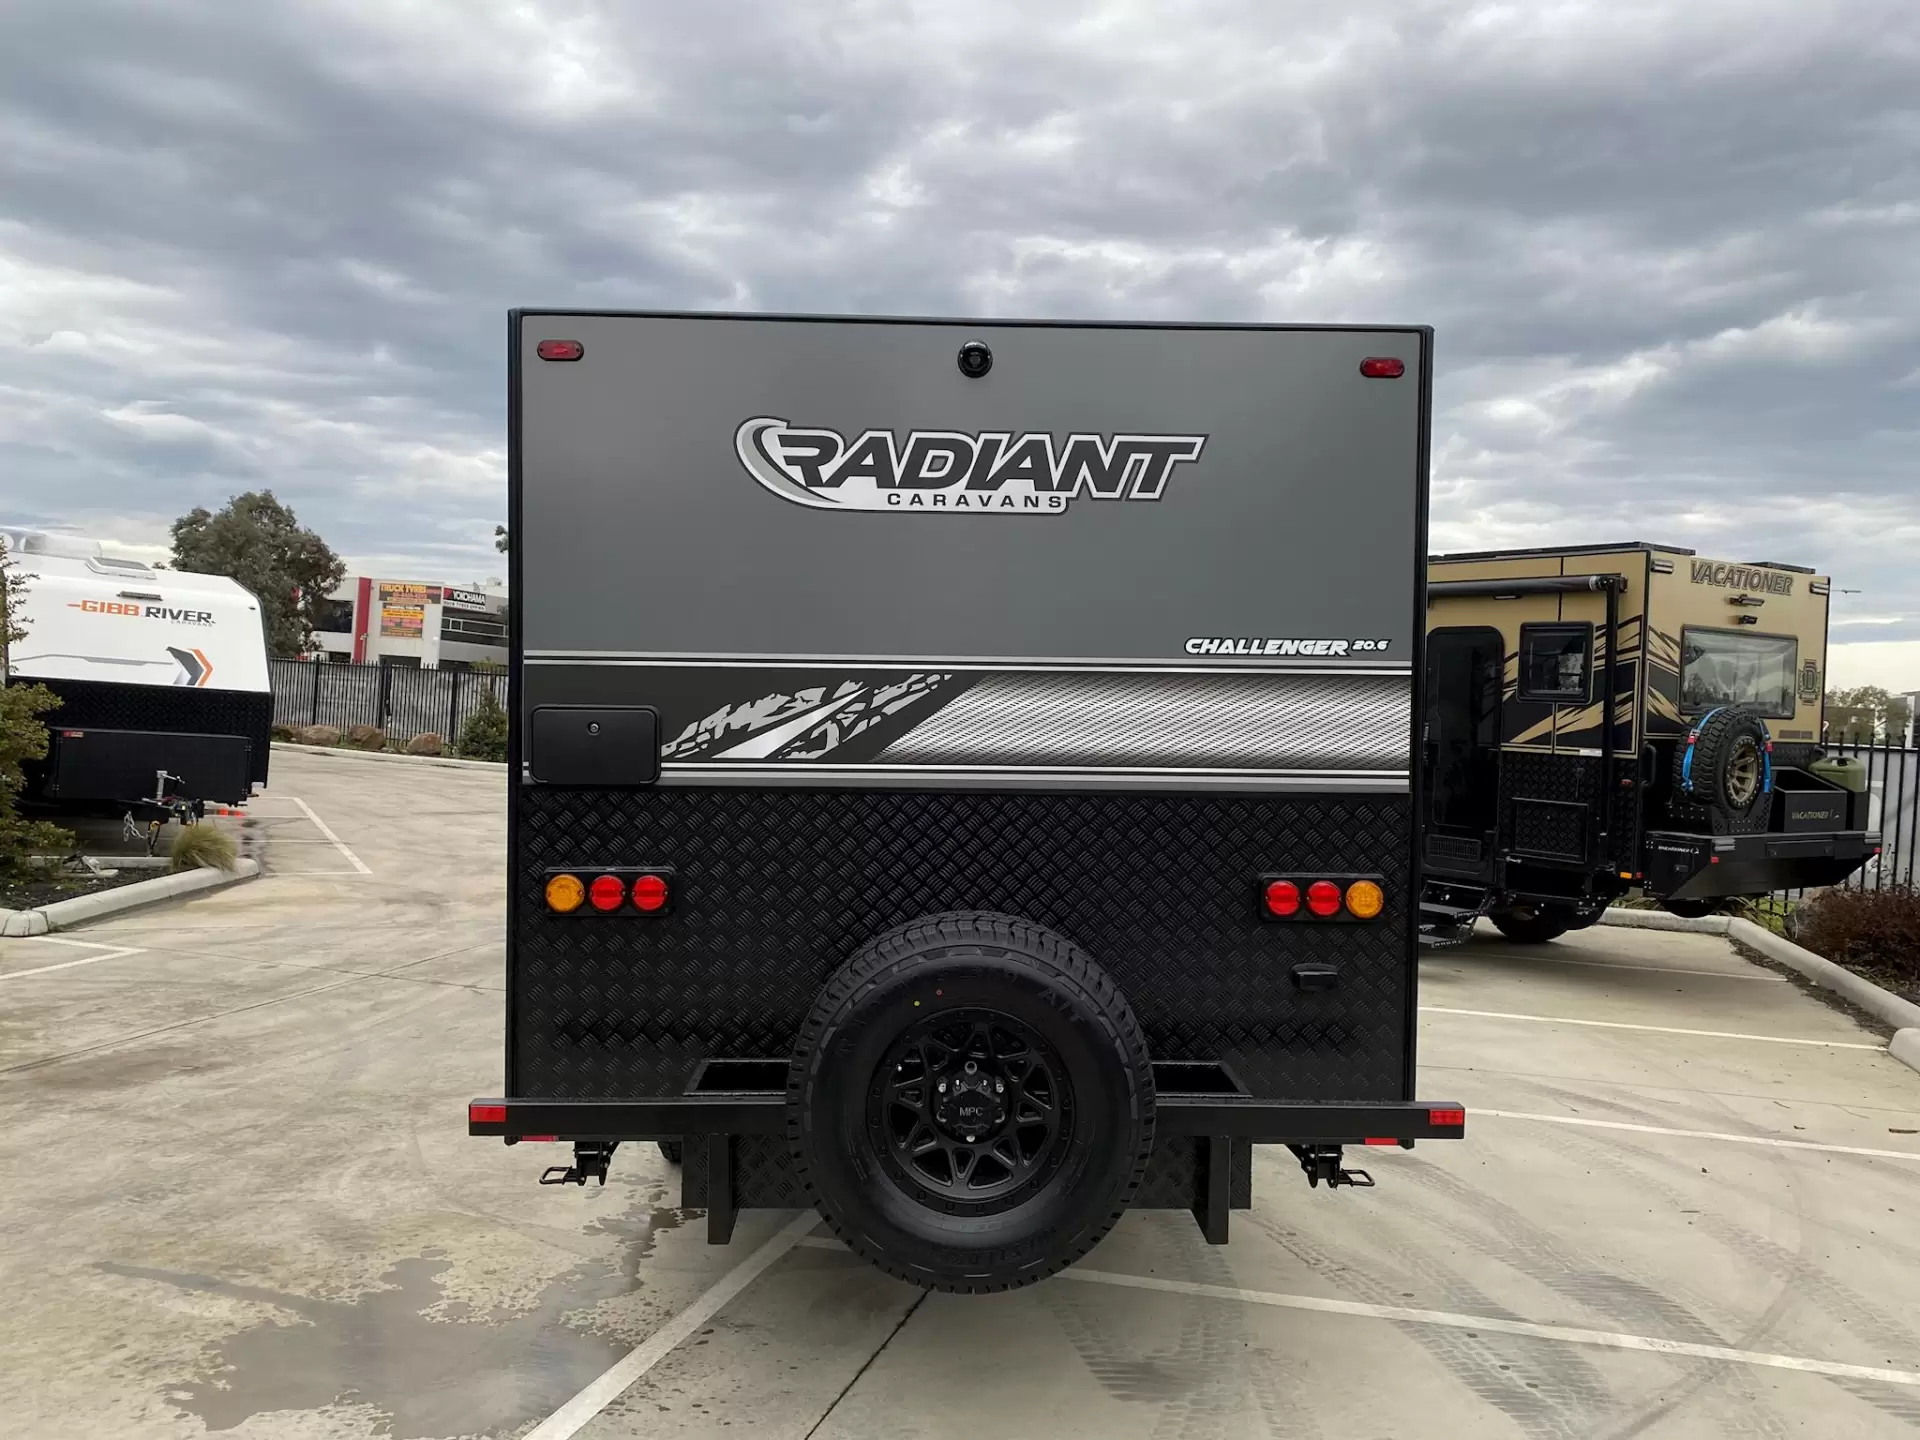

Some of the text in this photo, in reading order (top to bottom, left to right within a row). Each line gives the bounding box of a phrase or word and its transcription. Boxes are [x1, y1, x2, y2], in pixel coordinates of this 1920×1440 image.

[772, 432, 1203, 498] RADIANT
[886, 492, 1064, 509] CARAVANS
[1690, 559, 1794, 596] VACATIONER
[453, 590, 486, 604] YOKOHAMA
[79, 600, 214, 624] GIBB RIVER
[1185, 638, 1390, 656] CHALLENGER 20.6
[959, 1106, 984, 1117] MPC
